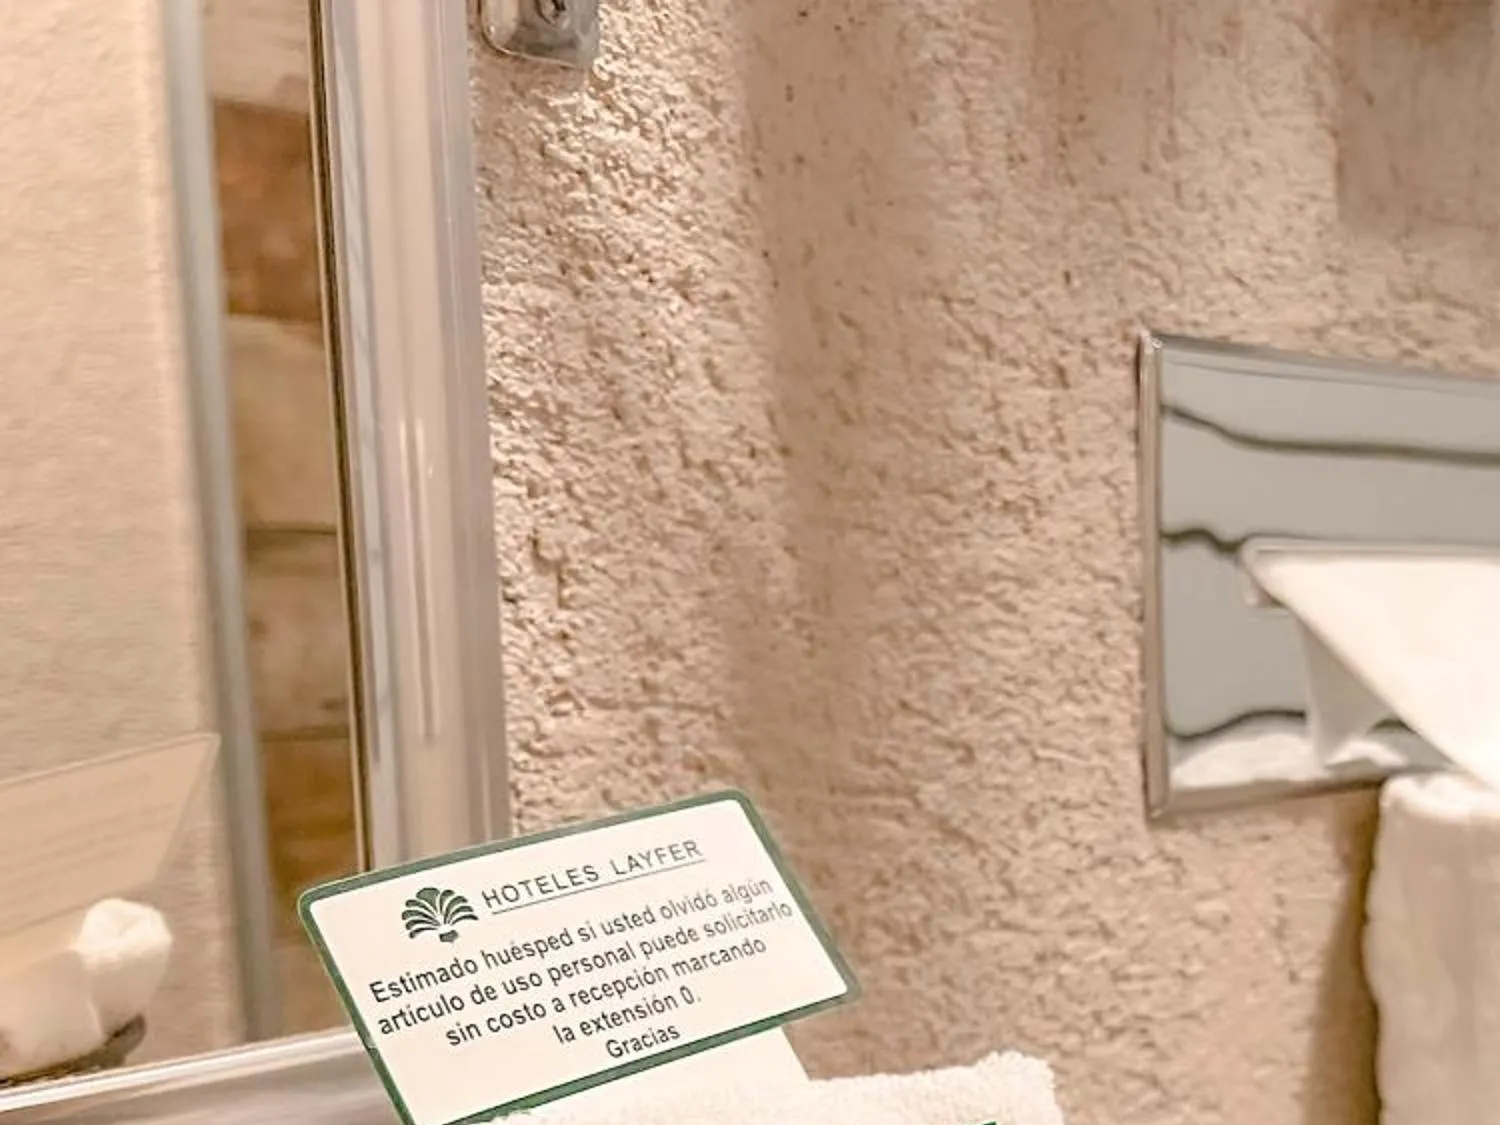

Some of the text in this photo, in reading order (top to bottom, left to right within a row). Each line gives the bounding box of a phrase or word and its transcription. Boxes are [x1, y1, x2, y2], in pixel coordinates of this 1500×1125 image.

[481, 840, 703, 909] HOTELES LAYFER
[370, 957, 479, 1003] Estimado
[577, 920, 597, 943] si
[600, 905, 656, 936] usted
[446, 937, 767, 1046] sin costo a recepción marcando
[470, 985, 498, 1005] de
[502, 973, 543, 996] uso
[547, 942, 636, 986] personal
[639, 926, 700, 960] puede
[703, 900, 793, 938] solicitarlo
[553, 1023, 576, 1045] la
[579, 991, 680, 1036] extensión
[605, 1025, 681, 1058] Gracias
